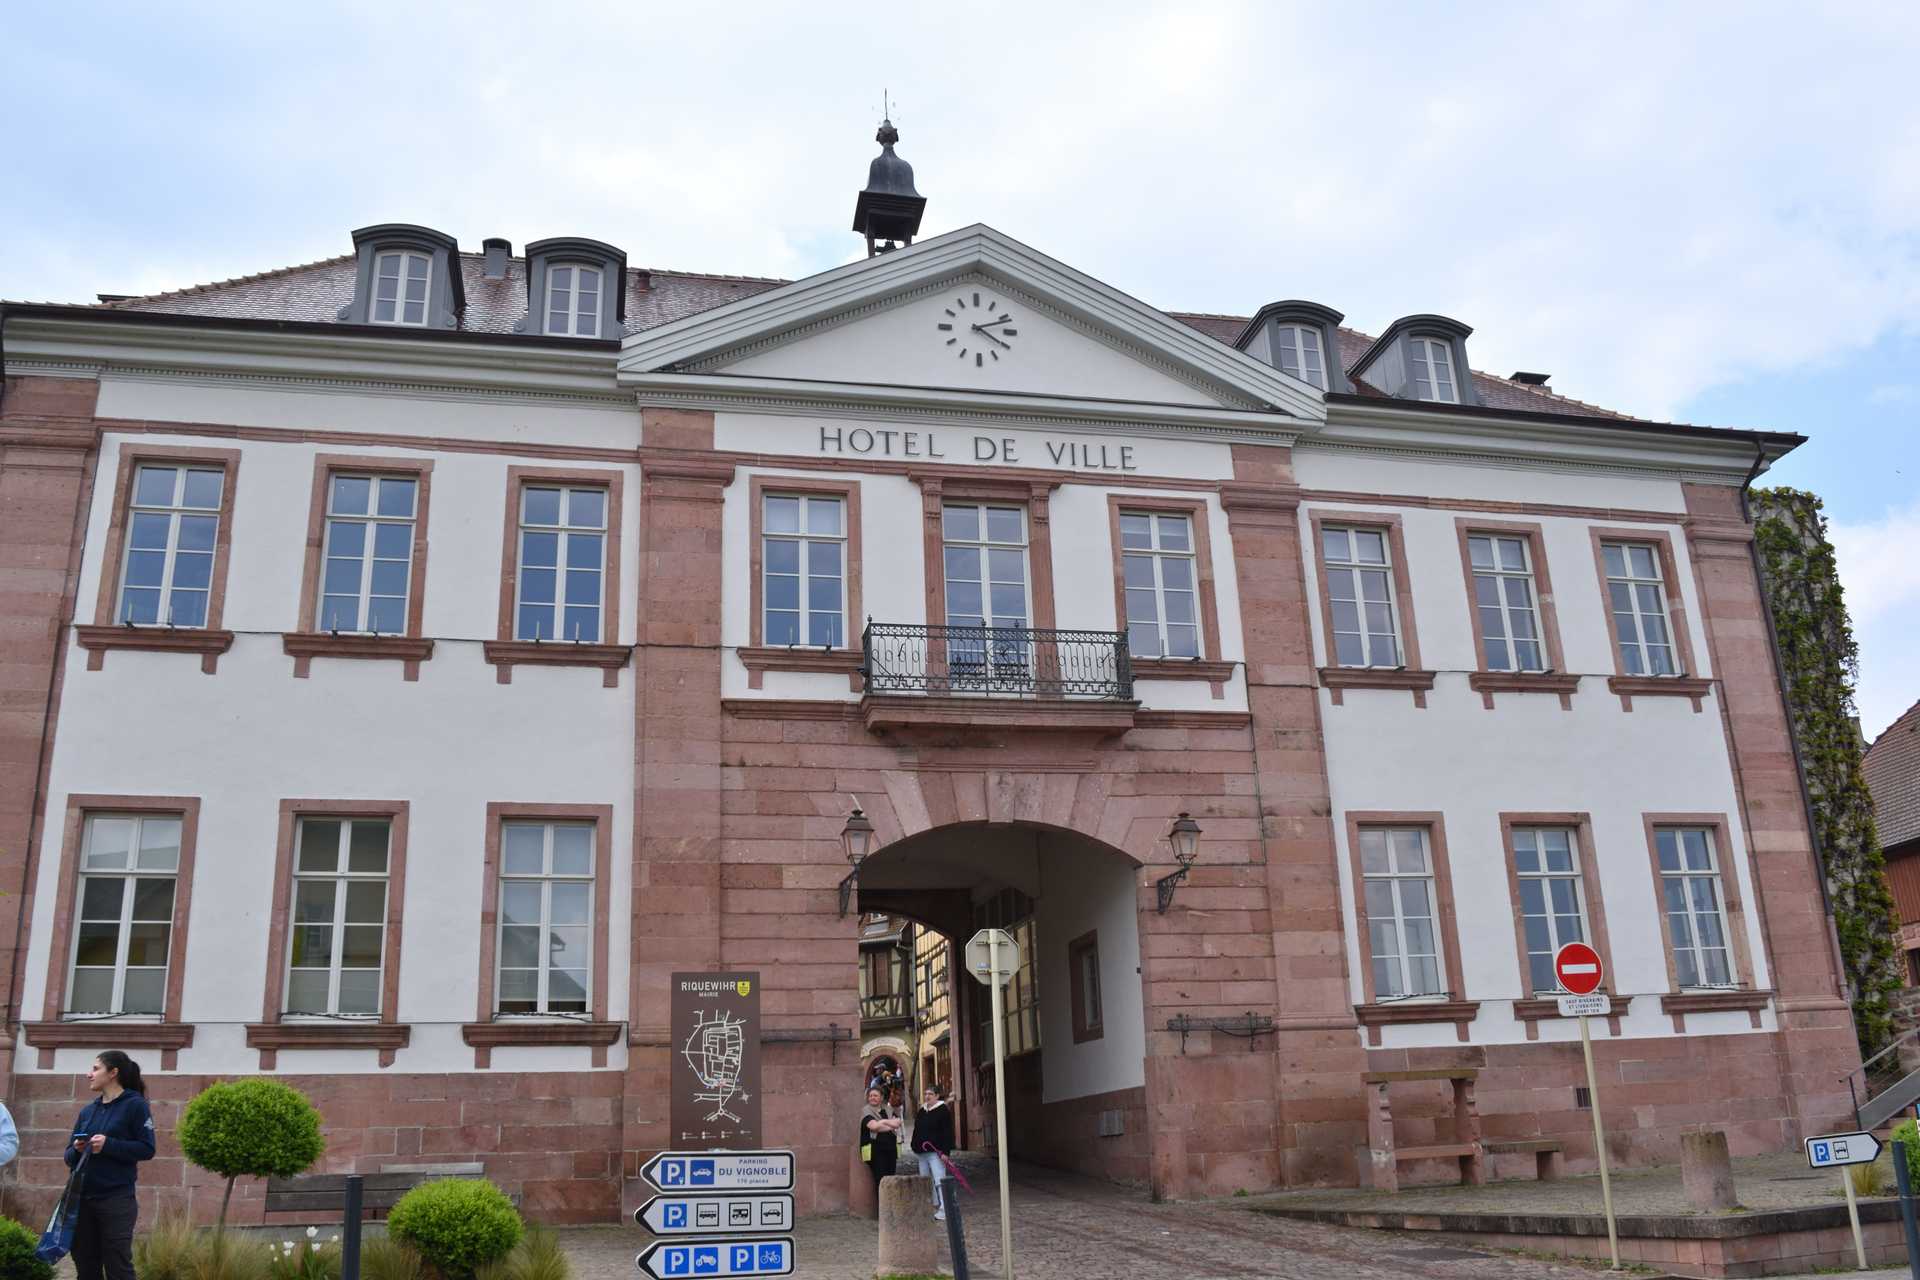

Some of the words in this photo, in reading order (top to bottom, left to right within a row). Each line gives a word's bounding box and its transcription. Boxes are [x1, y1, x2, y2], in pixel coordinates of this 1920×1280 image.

[819, 427, 945, 458] HOTEL
[974, 436, 1019, 463] DE
[1046, 441, 1138, 470] VILLE
[681, 981, 736, 991] RIQUEWIHR
[667, 1163, 681, 1182] P
[719, 1167, 733, 1176] DU
[736, 1166, 787, 1176] VIGNOBLE
[668, 1206, 682, 1225] P
[671, 1251, 684, 1272] P
[736, 1248, 749, 1269] P
